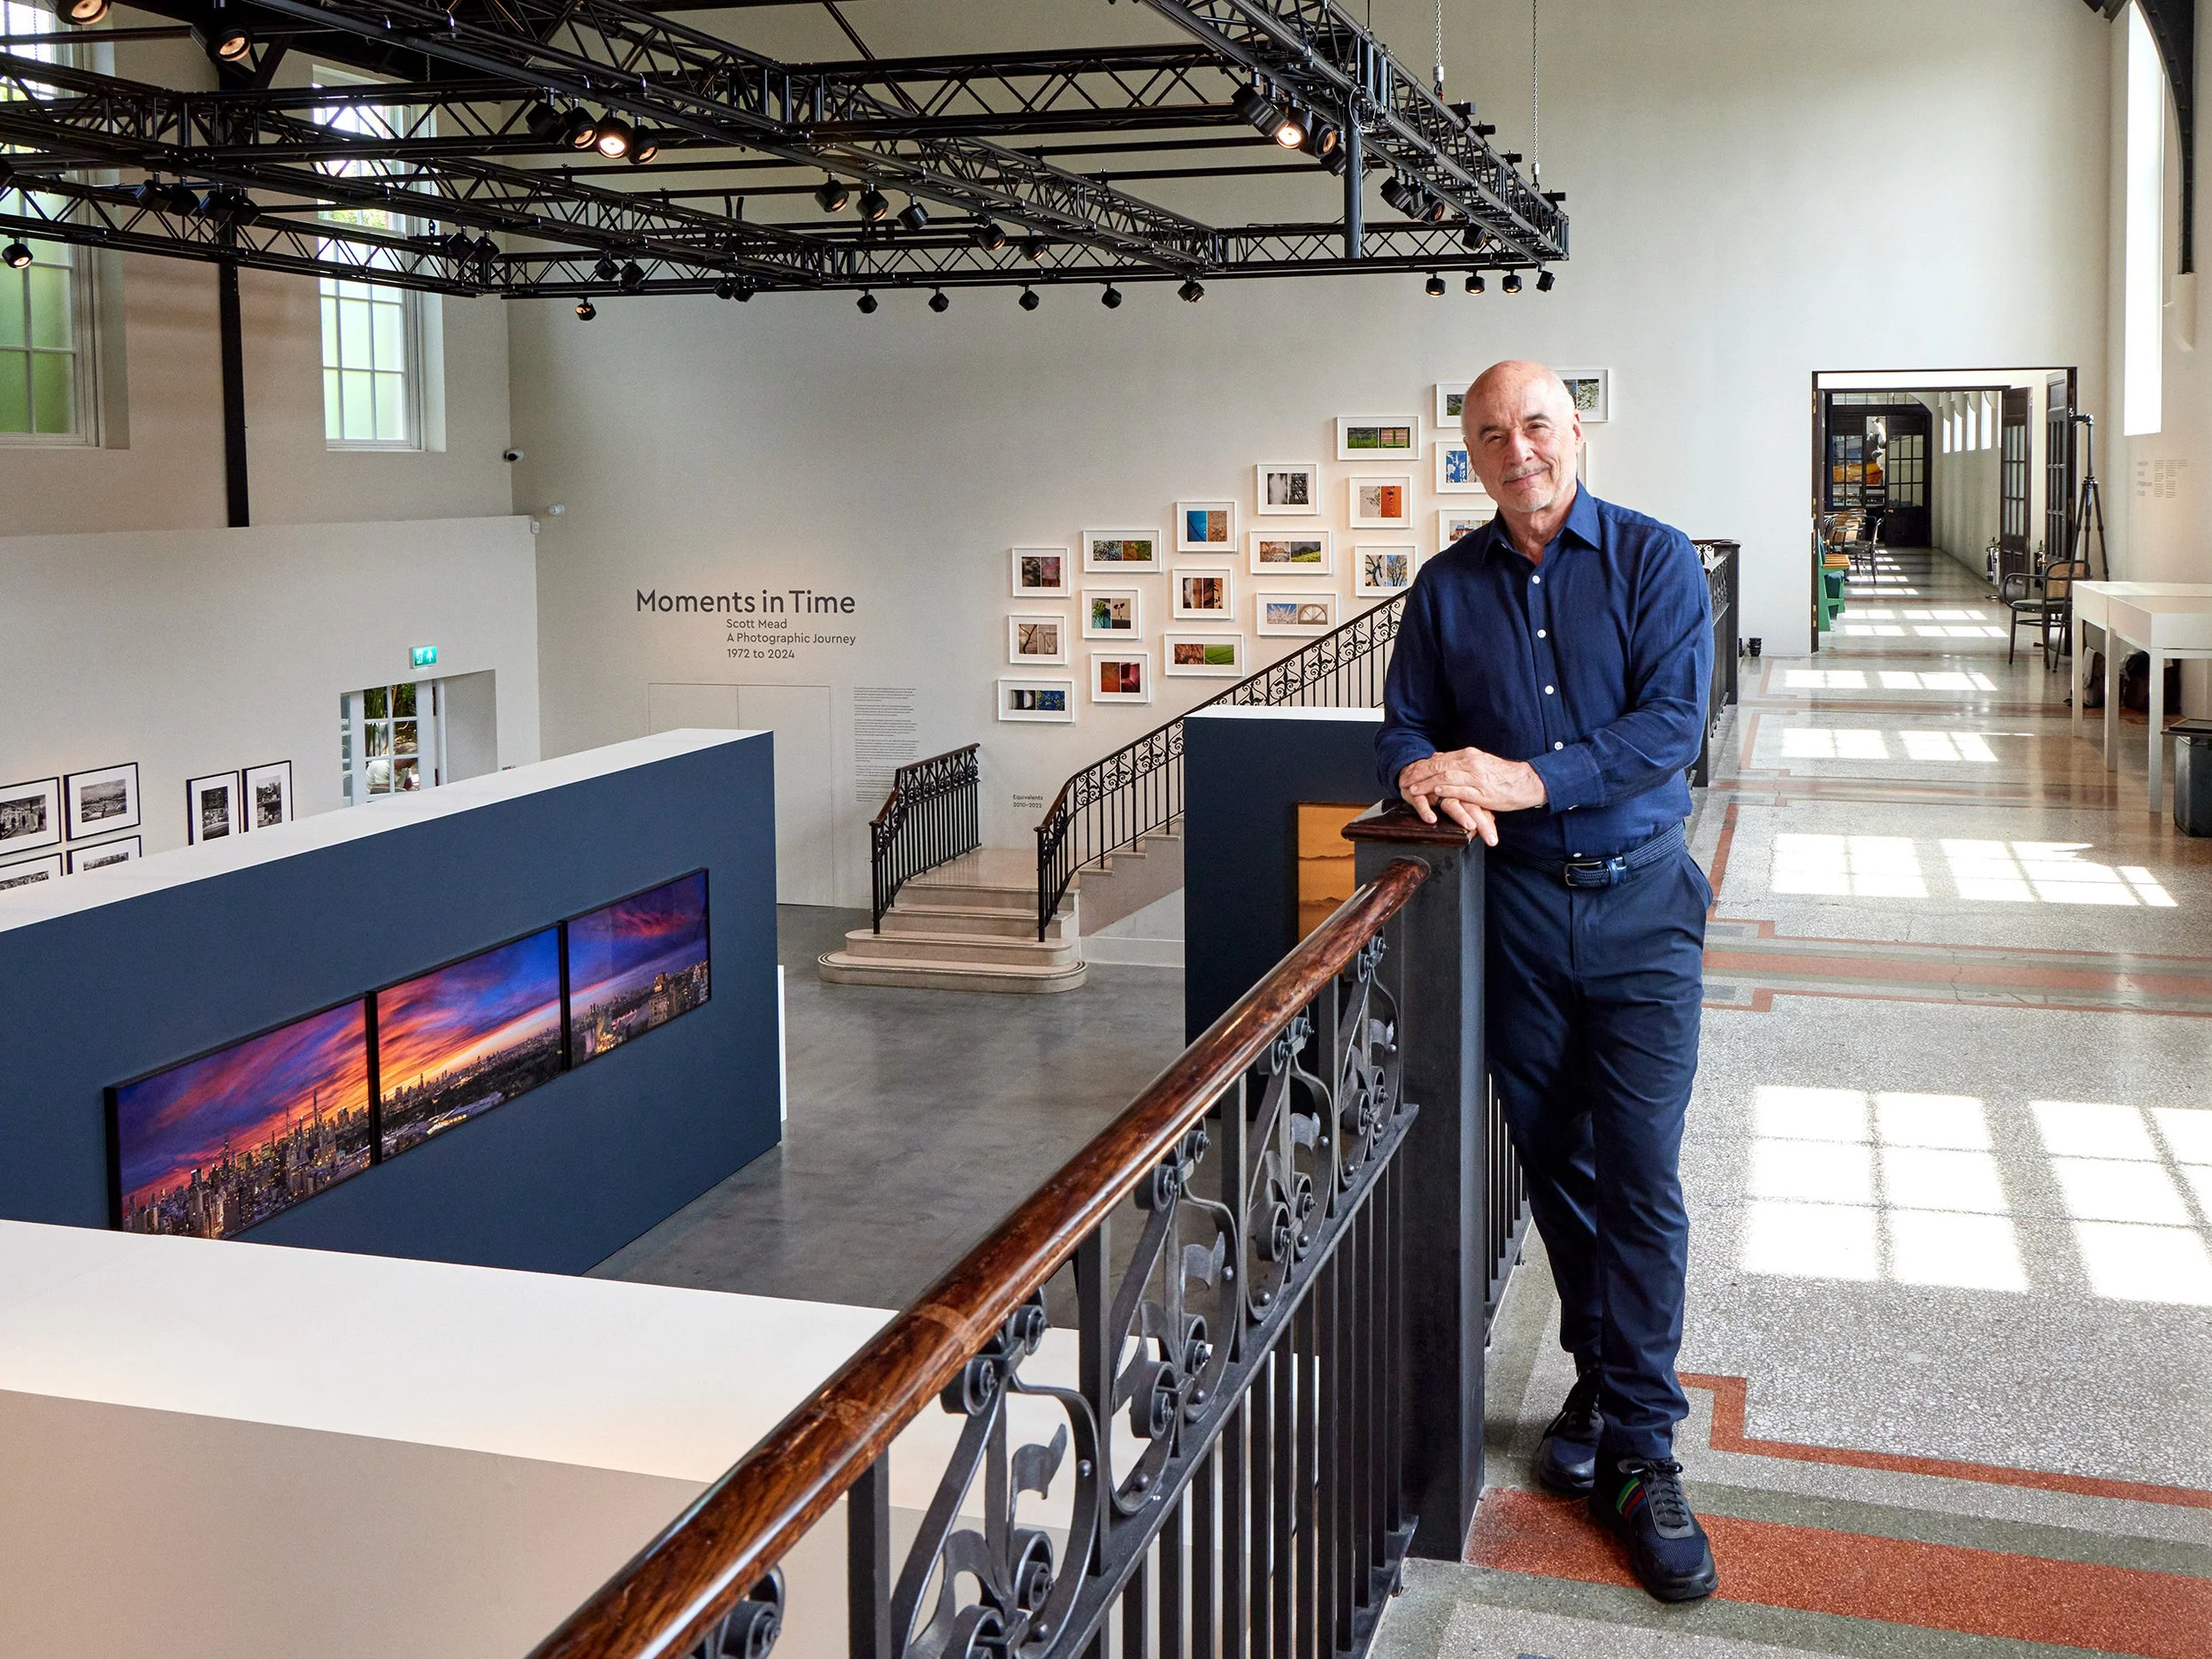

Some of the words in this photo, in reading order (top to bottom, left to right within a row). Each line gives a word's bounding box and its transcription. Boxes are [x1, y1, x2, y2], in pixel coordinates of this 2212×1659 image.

[636, 588, 756, 613] Moments
[762, 589, 784, 613] in
[788, 590, 856, 614] Time
[726, 618, 756, 629] Scott
[757, 618, 787, 629] Mead
[726, 633, 734, 642] A
[736, 632, 810, 644] Photographic
[812, 634, 856, 646] Journey
[726, 649, 750, 658] 1972
[753, 649, 765, 658] to
[767, 649, 795, 659] 2024
